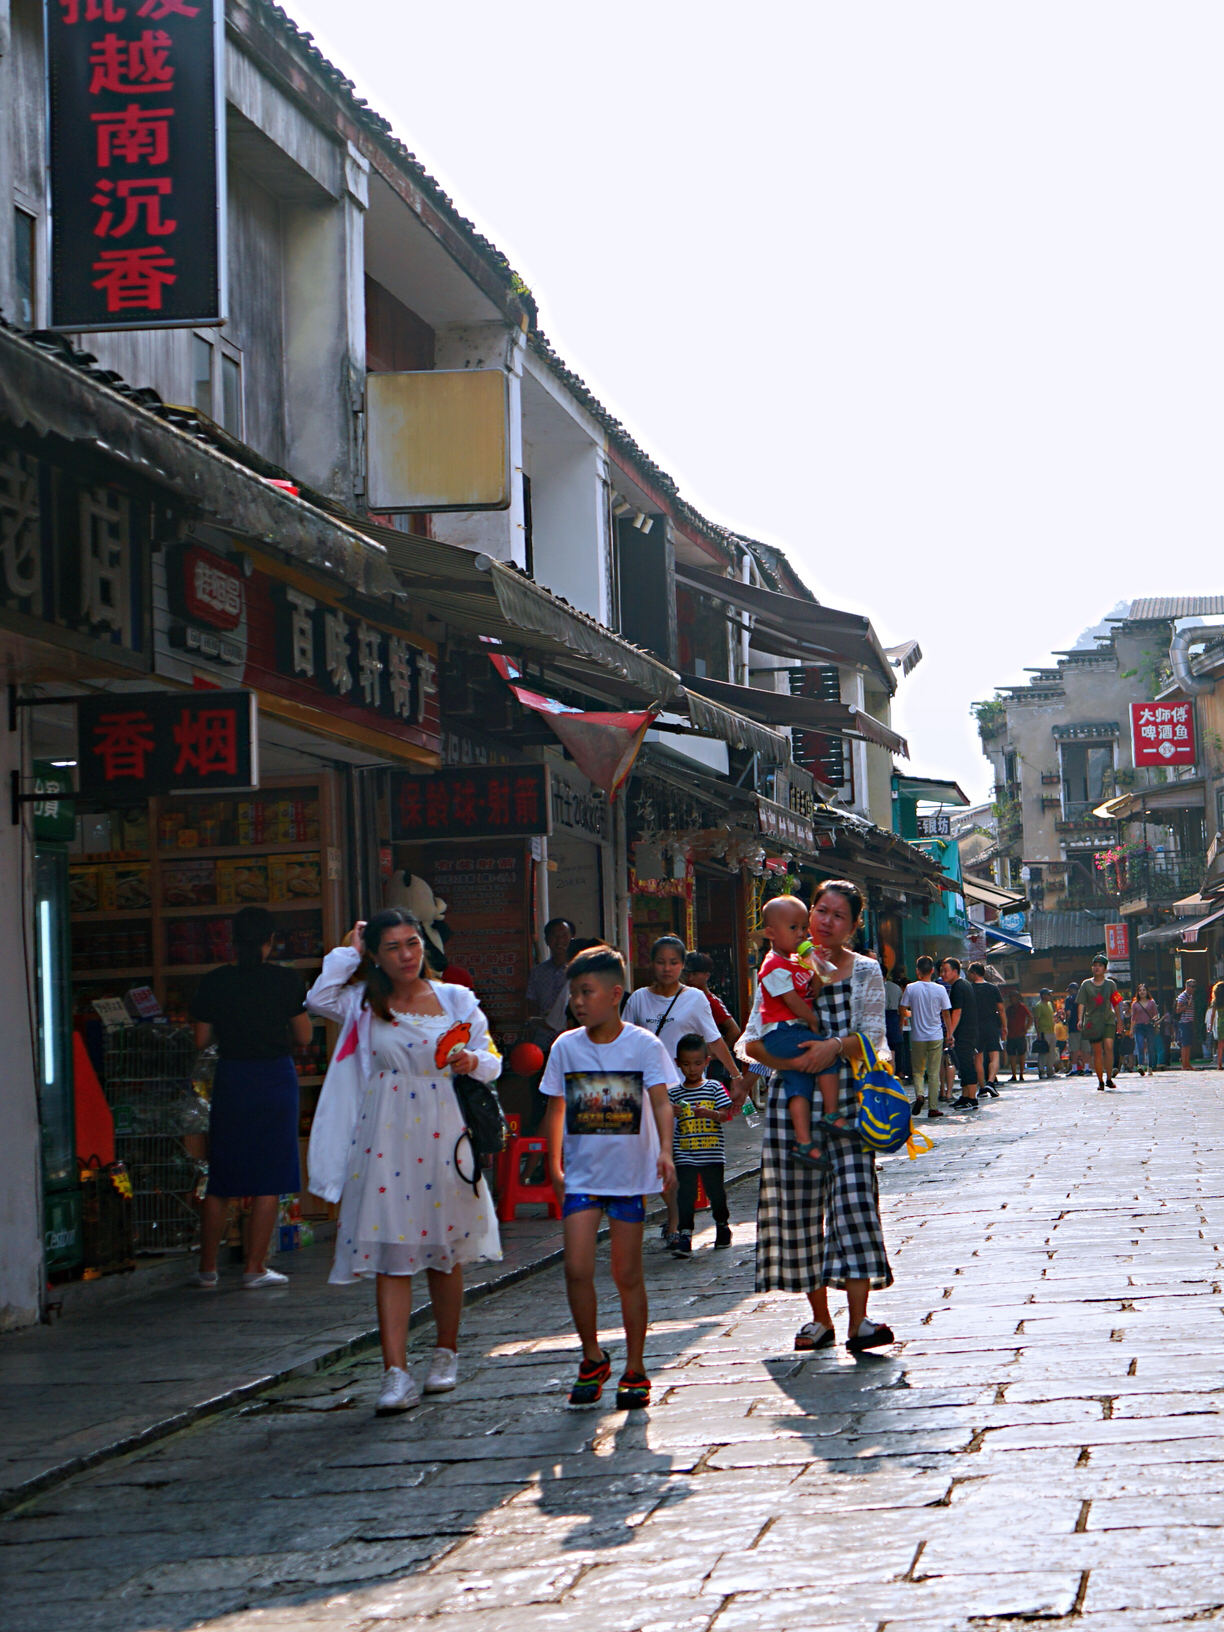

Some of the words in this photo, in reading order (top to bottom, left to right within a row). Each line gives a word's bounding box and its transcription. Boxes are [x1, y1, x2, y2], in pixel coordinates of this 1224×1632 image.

[89, 30, 177, 312] 越南沉香
[1138, 707, 1188, 724] 大师傅
[1141, 724, 1188, 741] 啤酒鱼
[93, 708, 237, 780] 香烟
